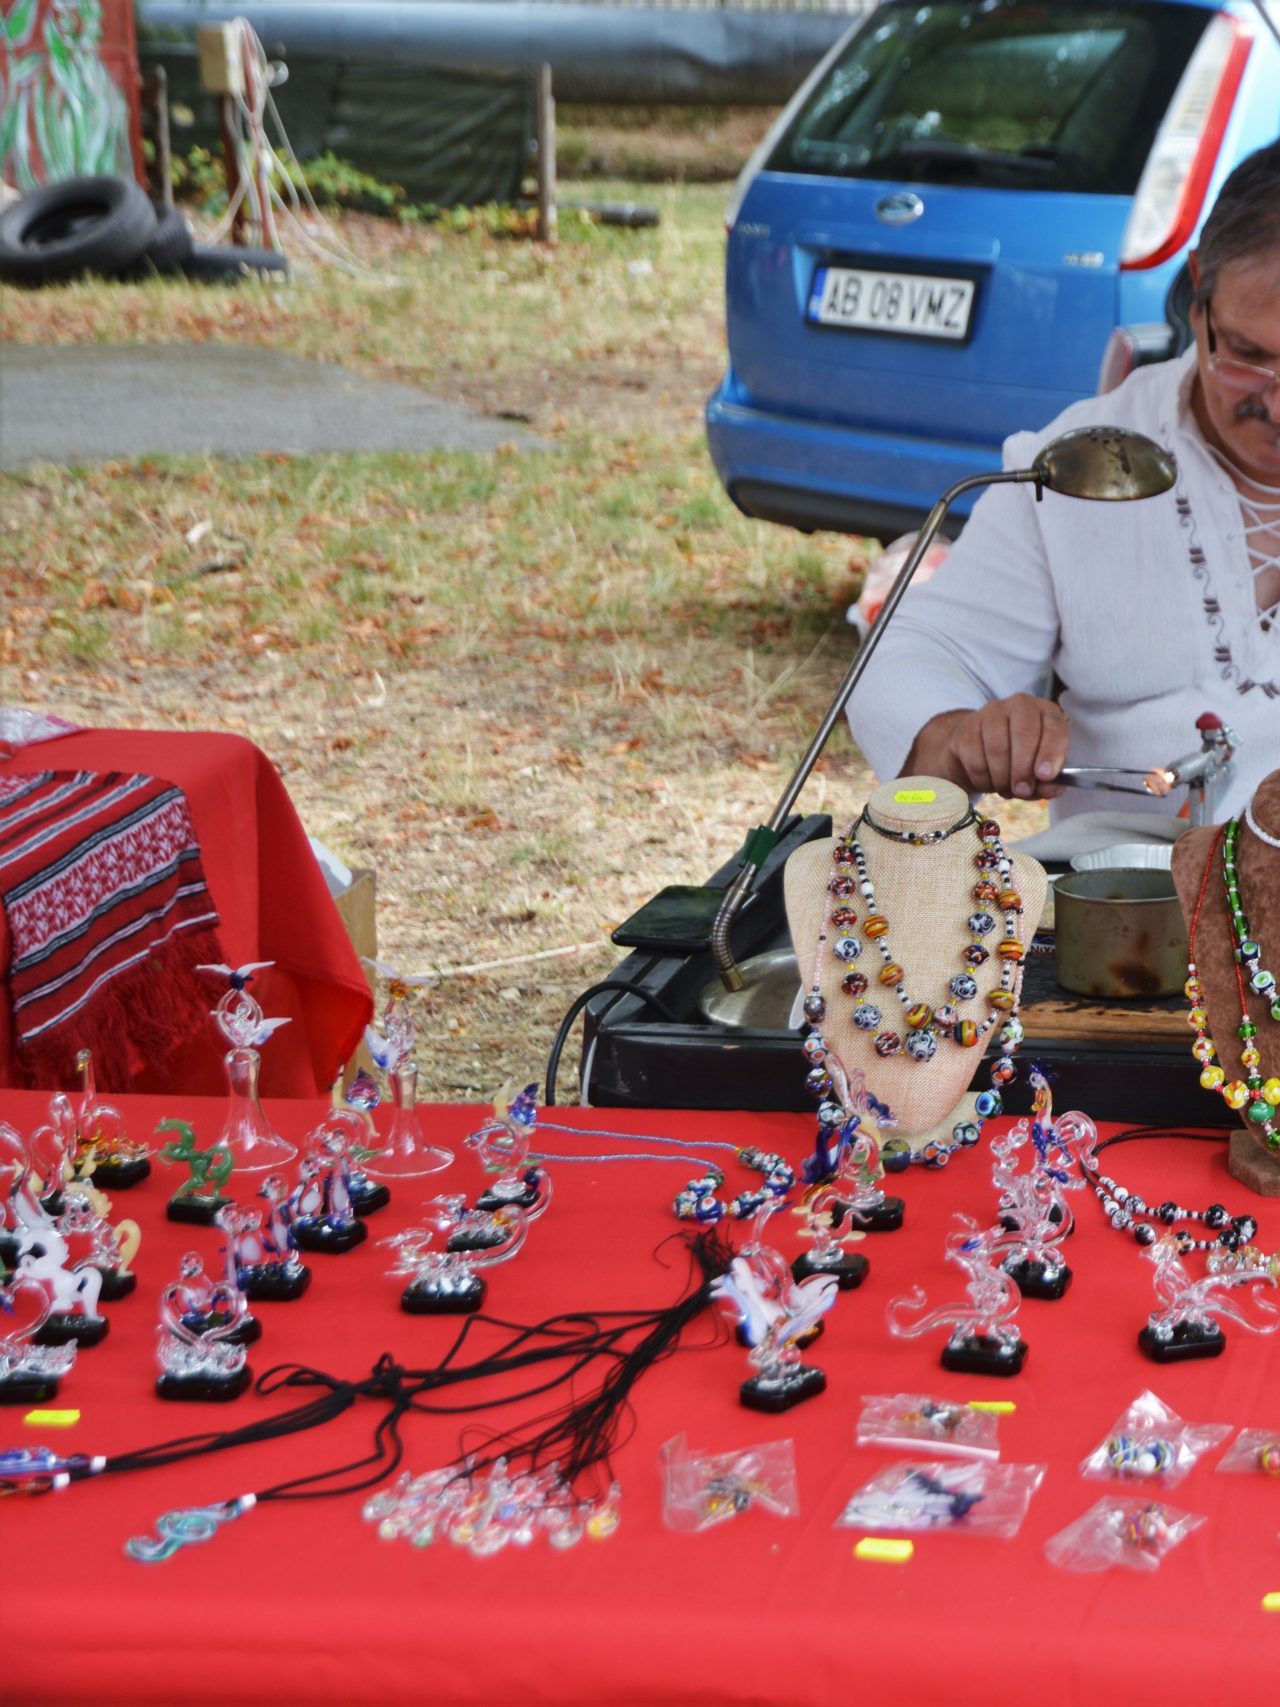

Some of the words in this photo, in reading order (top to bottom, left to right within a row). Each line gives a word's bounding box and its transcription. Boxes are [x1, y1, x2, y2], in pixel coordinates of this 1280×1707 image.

[827, 275, 861, 316] AB
[869, 278, 903, 321] 08
[909, 281, 965, 328] VMZ
